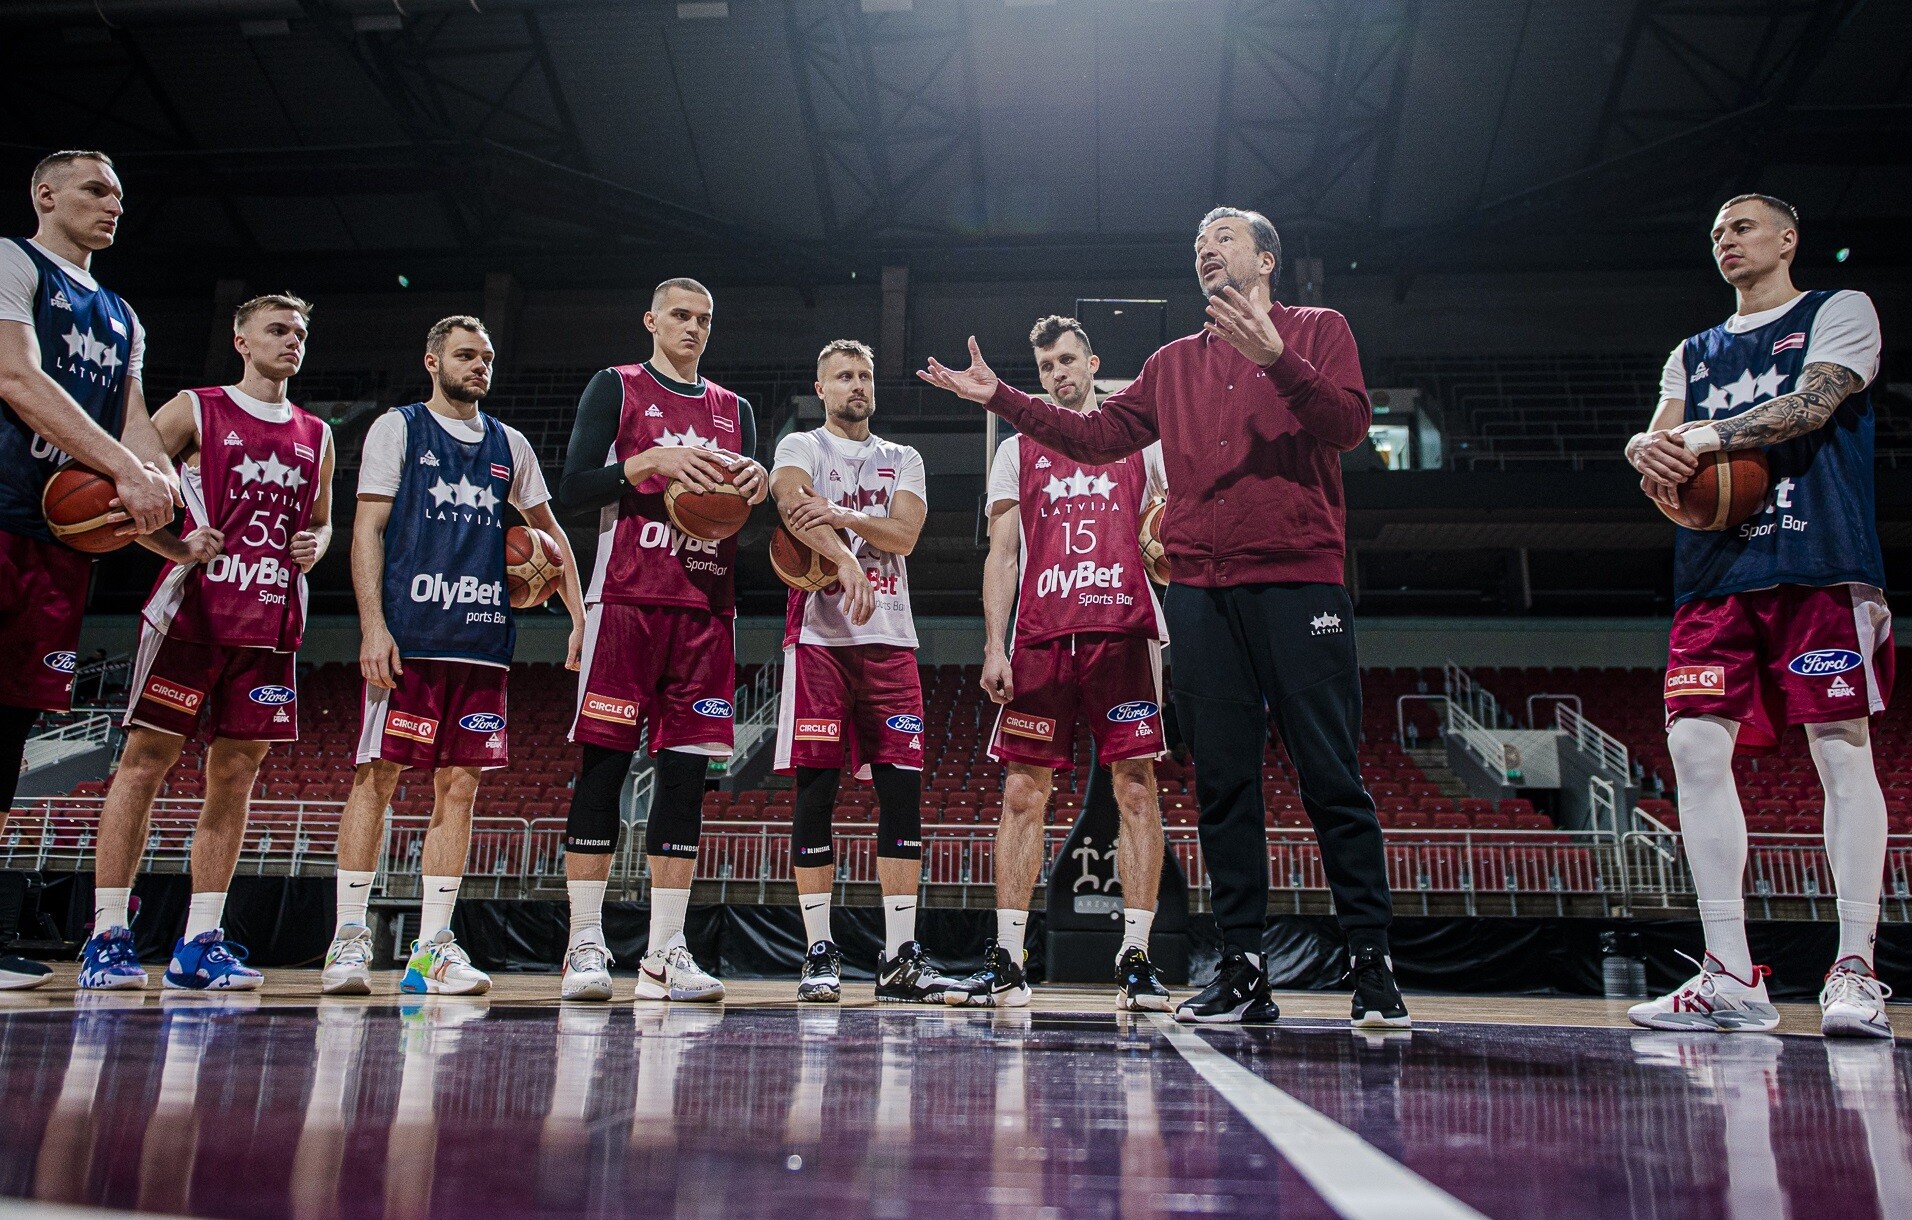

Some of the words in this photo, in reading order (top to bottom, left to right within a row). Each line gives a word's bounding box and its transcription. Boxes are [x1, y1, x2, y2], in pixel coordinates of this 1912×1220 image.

[51, 297, 72, 311] PEAK
[645, 410, 663, 418] PEAK
[420, 457, 440, 467] PEAK
[1035, 461, 1052, 470] PEAK
[230, 489, 301, 512] LATVIJA
[1041, 502, 1120, 518] LATVIJA
[425, 508, 502, 529] LATVIJA
[1781, 514, 1808, 532] Bar
[241, 510, 290, 550] 55
[1061, 519, 1097, 555] 15
[1037, 561, 1124, 599] OlyBet
[410, 572, 502, 610] OlyBet
[1078, 593, 1114, 607] Sports
[1115, 593, 1134, 606] Bar
[493, 611, 507, 625] Bar
[1311, 627, 1343, 636] LATVIJA
[1802, 651, 1849, 674] Ford
[1668, 674, 1698, 687] CIRCLE
[151, 683, 186, 702] CIRCLE
[258, 687, 290, 702] Ford
[1828, 687, 1855, 698] PEAK
[589, 700, 623, 715] CIRCLE
[701, 699, 730, 717] Ford
[1117, 702, 1150, 721] Ford
[273, 715, 290, 723] PEAK
[392, 717, 418, 732] CIRCLE
[468, 714, 500, 730] Ford
[895, 716, 922, 731] Ford
[1006, 716, 1035, 730] CIRCLE
[799, 723, 827, 734] CIRCLE
[575, 838, 611, 847] BLINDSAVE
[1077, 901, 1119, 909] ARENA
